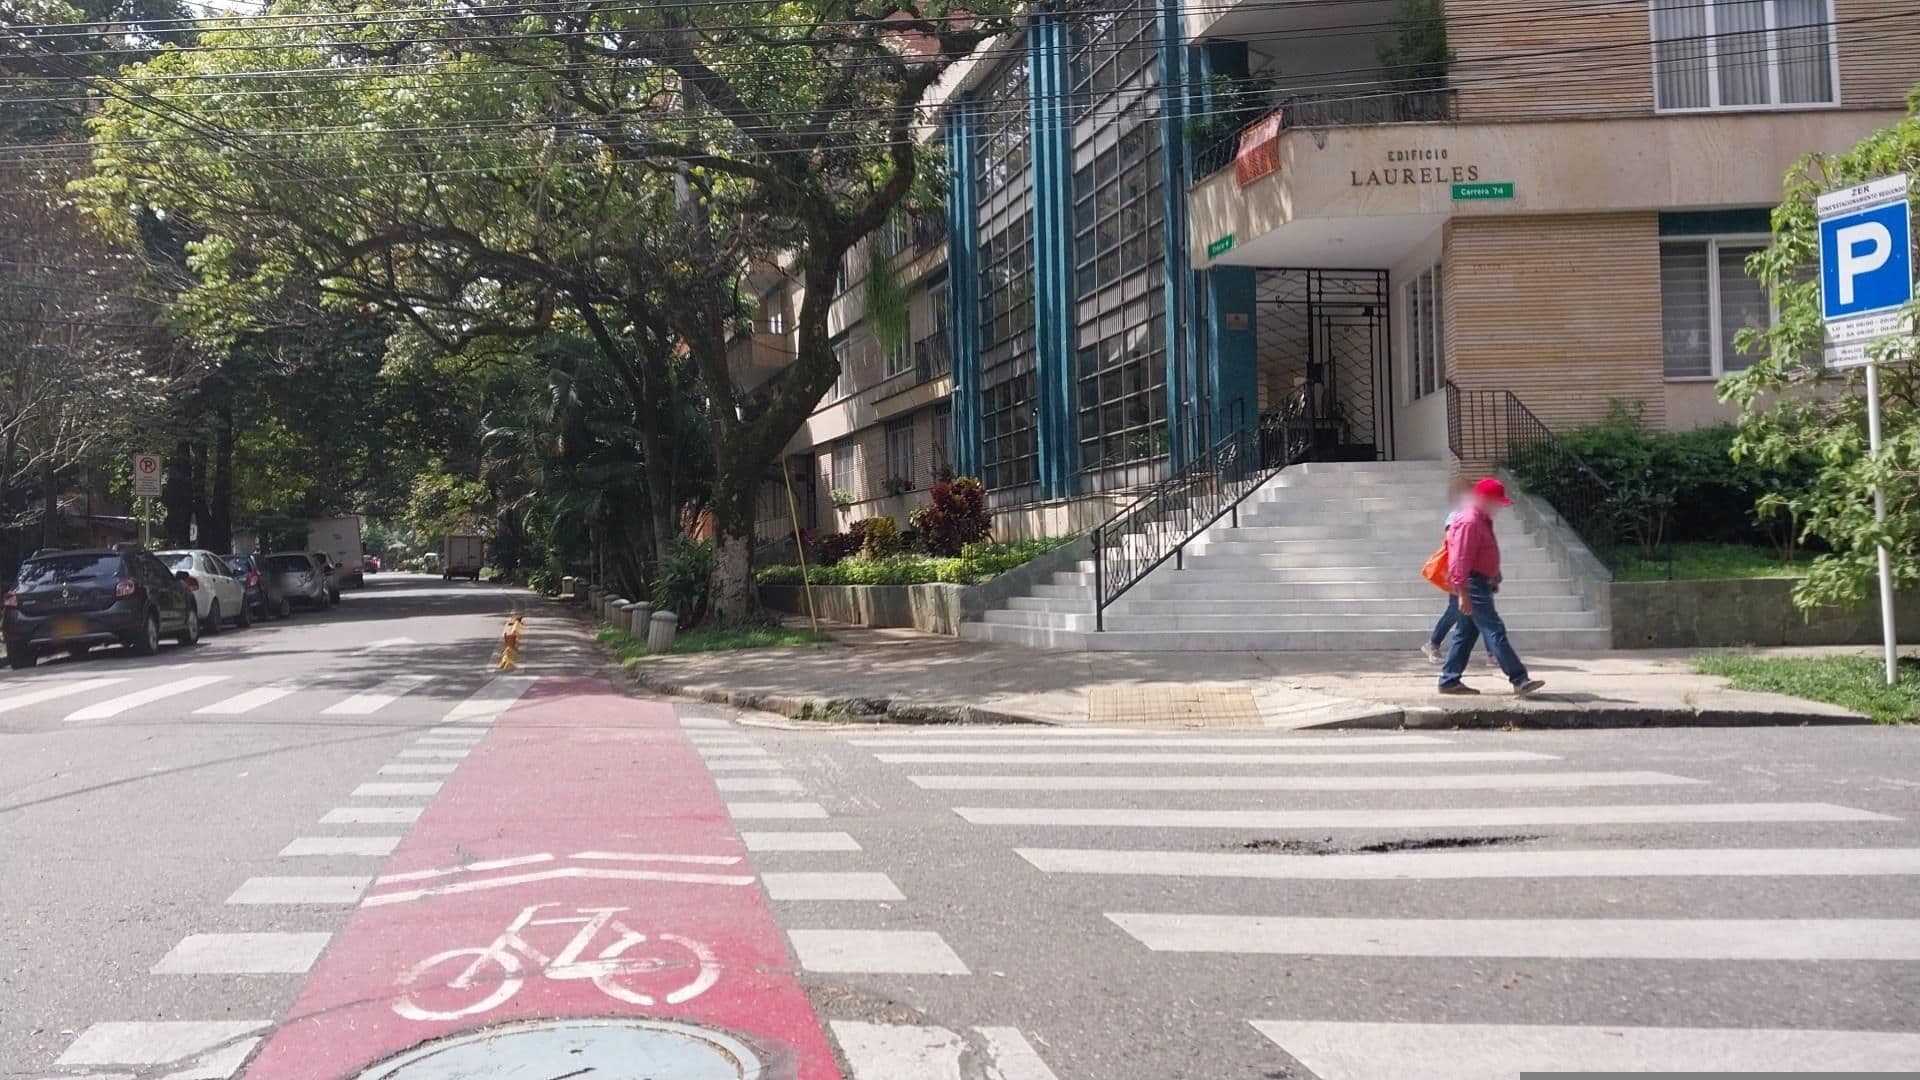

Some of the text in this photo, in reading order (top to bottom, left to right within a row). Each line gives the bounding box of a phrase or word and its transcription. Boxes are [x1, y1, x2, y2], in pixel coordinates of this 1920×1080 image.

[1387, 149, 1448, 162] EDIFICIO
[1351, 165, 1479, 186] LAURELES
[1460, 186, 1504, 196] Carrera 74
[1851, 185, 1870, 197] ZER
[1836, 221, 1892, 305] P
